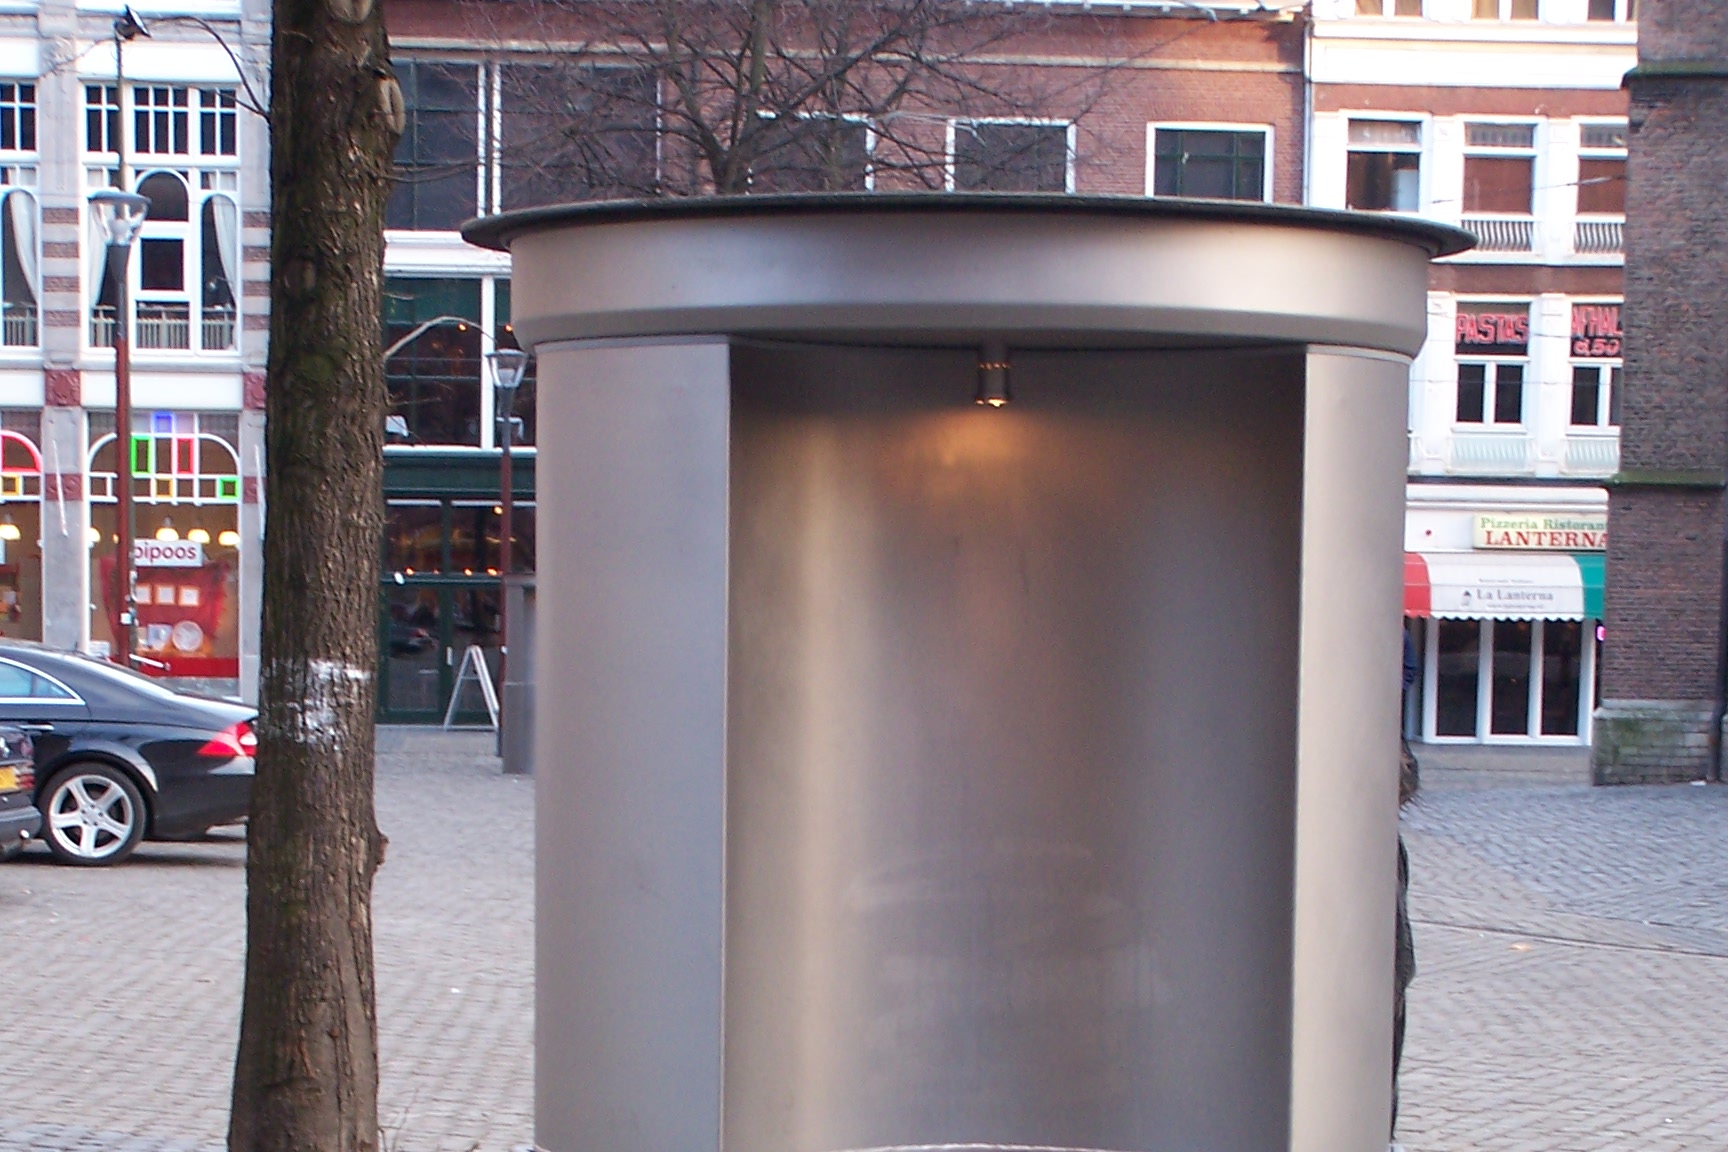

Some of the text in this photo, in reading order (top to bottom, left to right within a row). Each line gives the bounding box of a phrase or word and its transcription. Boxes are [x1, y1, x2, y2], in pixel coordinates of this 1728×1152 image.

[1456, 313, 1528, 344] PASTAS
[1481, 517, 1538, 529] Pizzeria
[1477, 589, 1554, 601] La Lanterna
